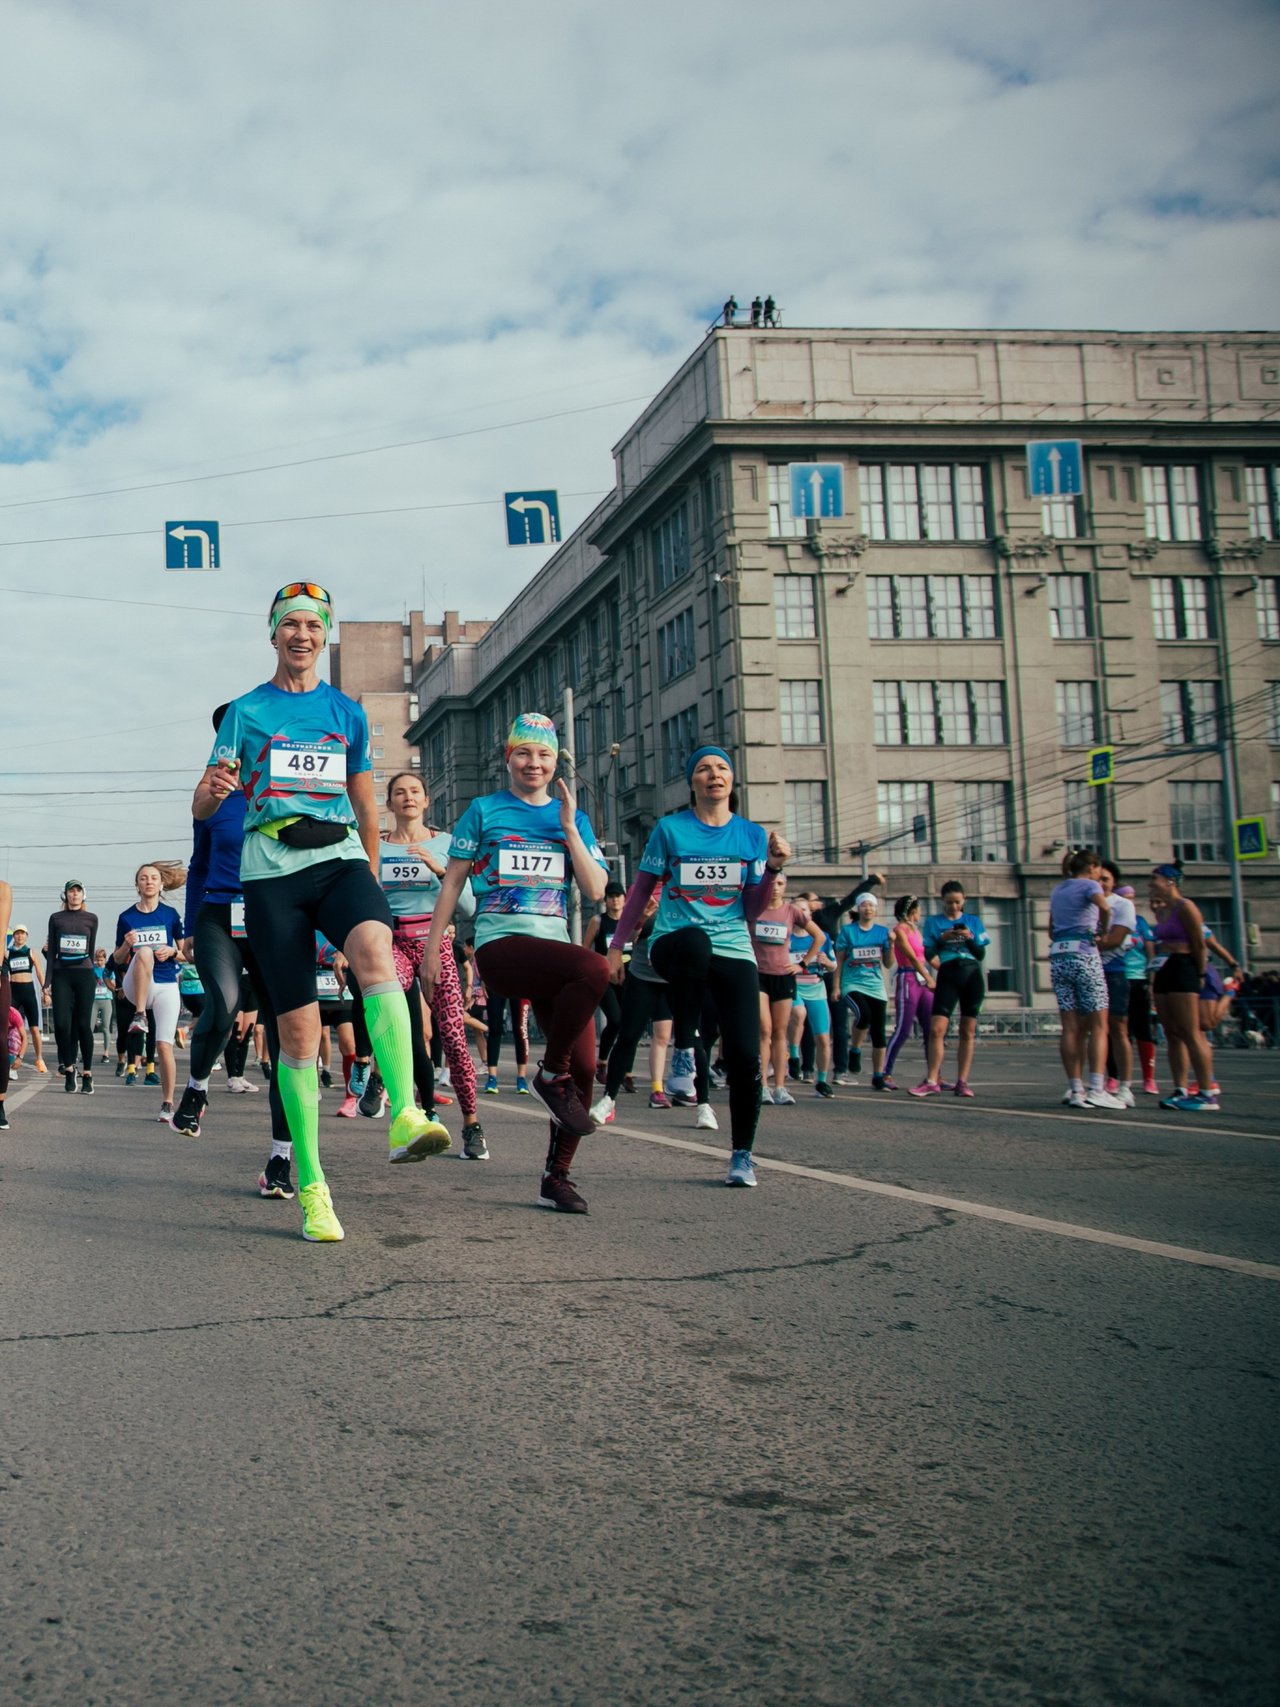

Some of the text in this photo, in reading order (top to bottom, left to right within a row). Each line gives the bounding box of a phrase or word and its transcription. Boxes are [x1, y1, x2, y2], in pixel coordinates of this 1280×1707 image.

[288, 754, 329, 773] 487
[511, 855, 553, 872] 1177
[392, 866, 420, 878] 959
[694, 865, 728, 879] 633
[763, 927, 780, 936] 971
[137, 933, 161, 943] 1162
[66, 940, 81, 948] 736
[857, 949, 877, 957] 1120
